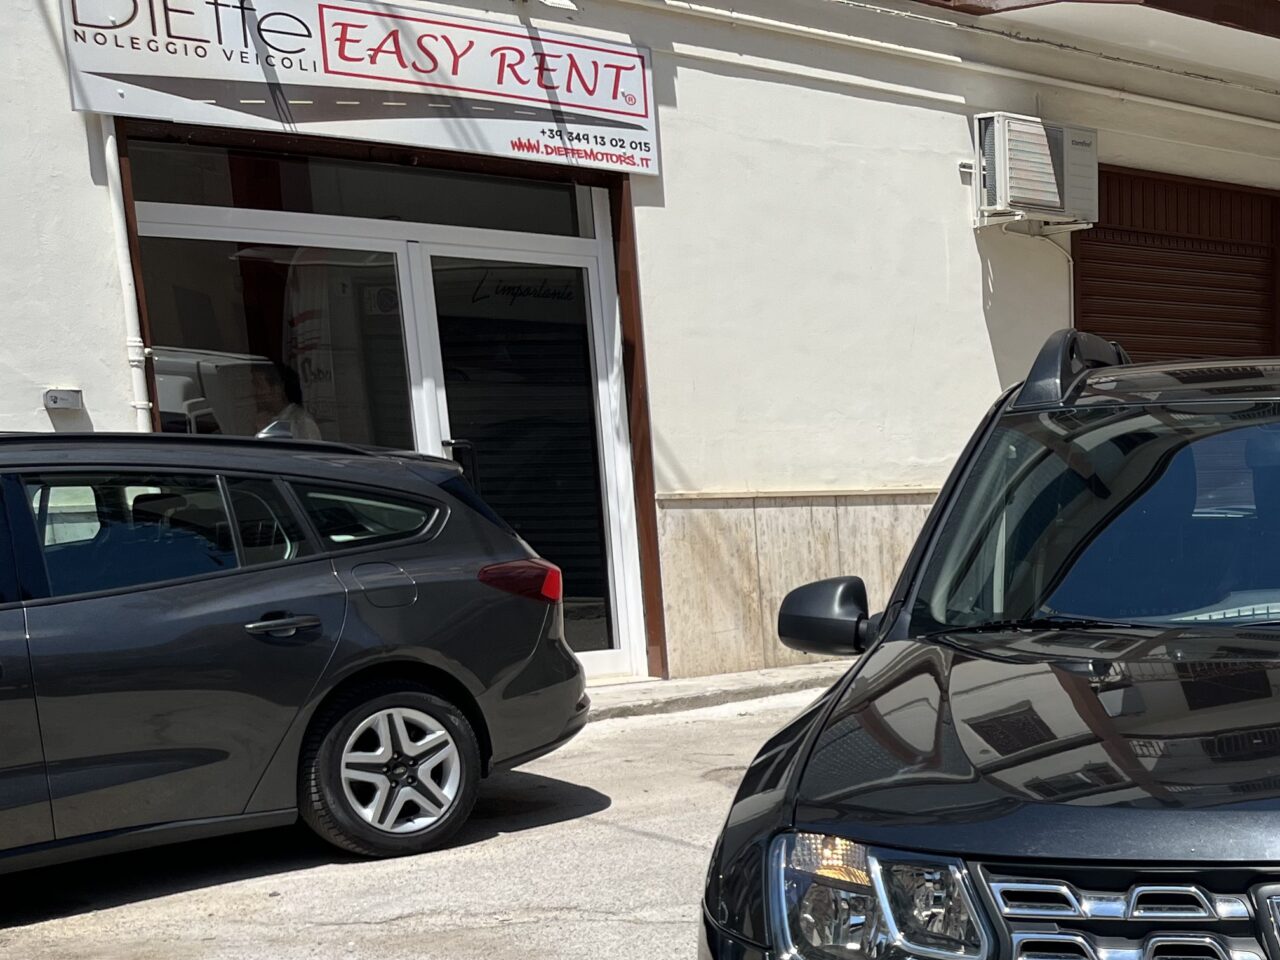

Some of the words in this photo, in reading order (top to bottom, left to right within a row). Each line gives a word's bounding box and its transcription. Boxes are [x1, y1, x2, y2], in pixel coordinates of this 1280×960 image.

[73, 29, 208, 59] NOLEGGIO
[222, 49, 317, 73] VEICOLI
[331, 22, 475, 76] EASY
[490, 46, 636, 100] RENT
[540, 128, 563, 140] +39
[567, 131, 589, 144] 349
[593, 135, 606, 146] 13
[610, 137, 626, 149] 02
[629, 140, 651, 152] 015
